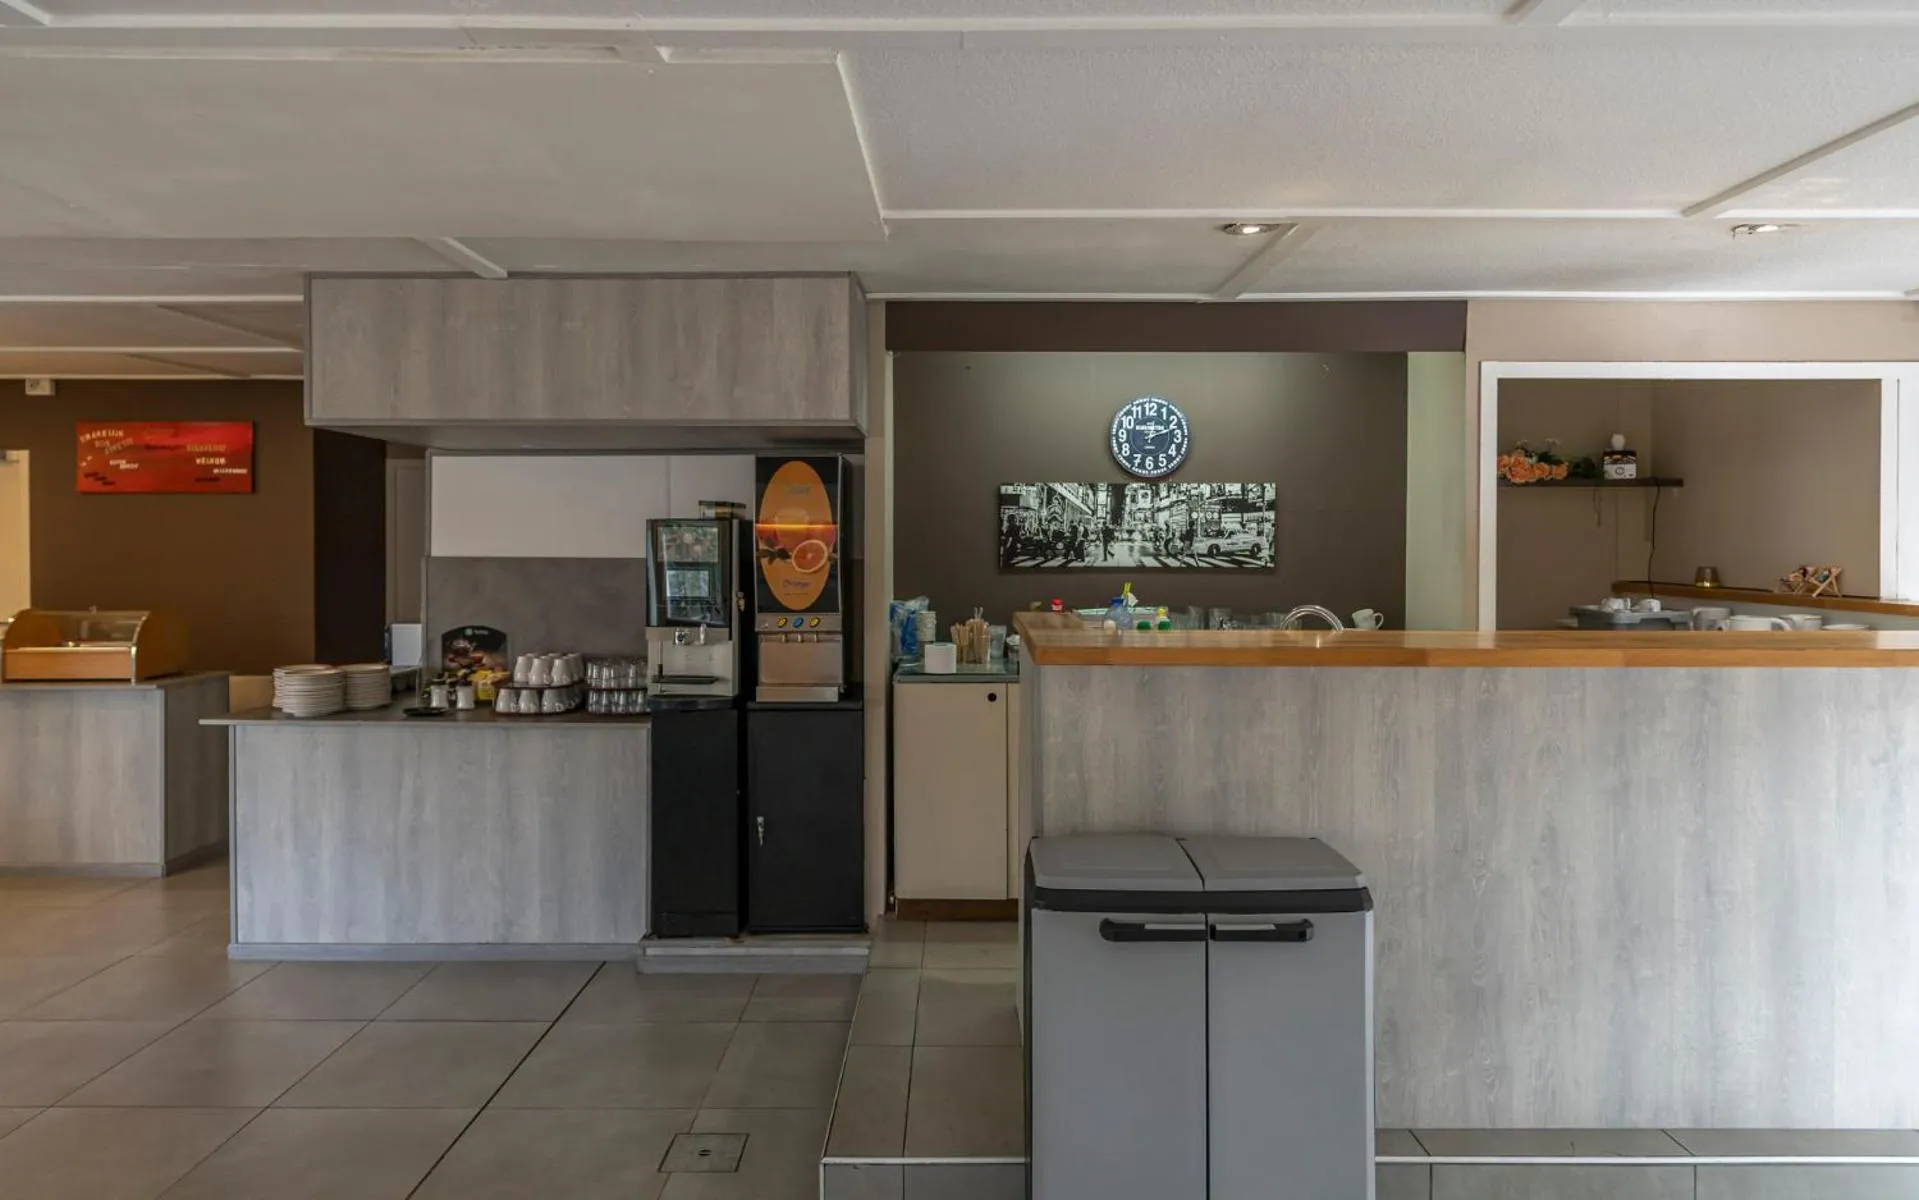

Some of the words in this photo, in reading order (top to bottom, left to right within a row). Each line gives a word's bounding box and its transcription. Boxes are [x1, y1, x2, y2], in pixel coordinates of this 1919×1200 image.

[1131, 405, 1142, 419] 11
[1143, 402, 1158, 417] 12
[1160, 406, 1167, 420] 1
[1121, 415, 1134, 429] 10
[1169, 415, 1178, 429] 2
[1118, 429, 1127, 442] 9
[1173, 429, 1182, 443] 3
[1121, 443, 1130, 457] 8
[1168, 443, 1177, 457] 4
[1133, 453, 1142, 467] 7
[1145, 456, 1154, 470] 6
[1158, 453, 1167, 467] 5
